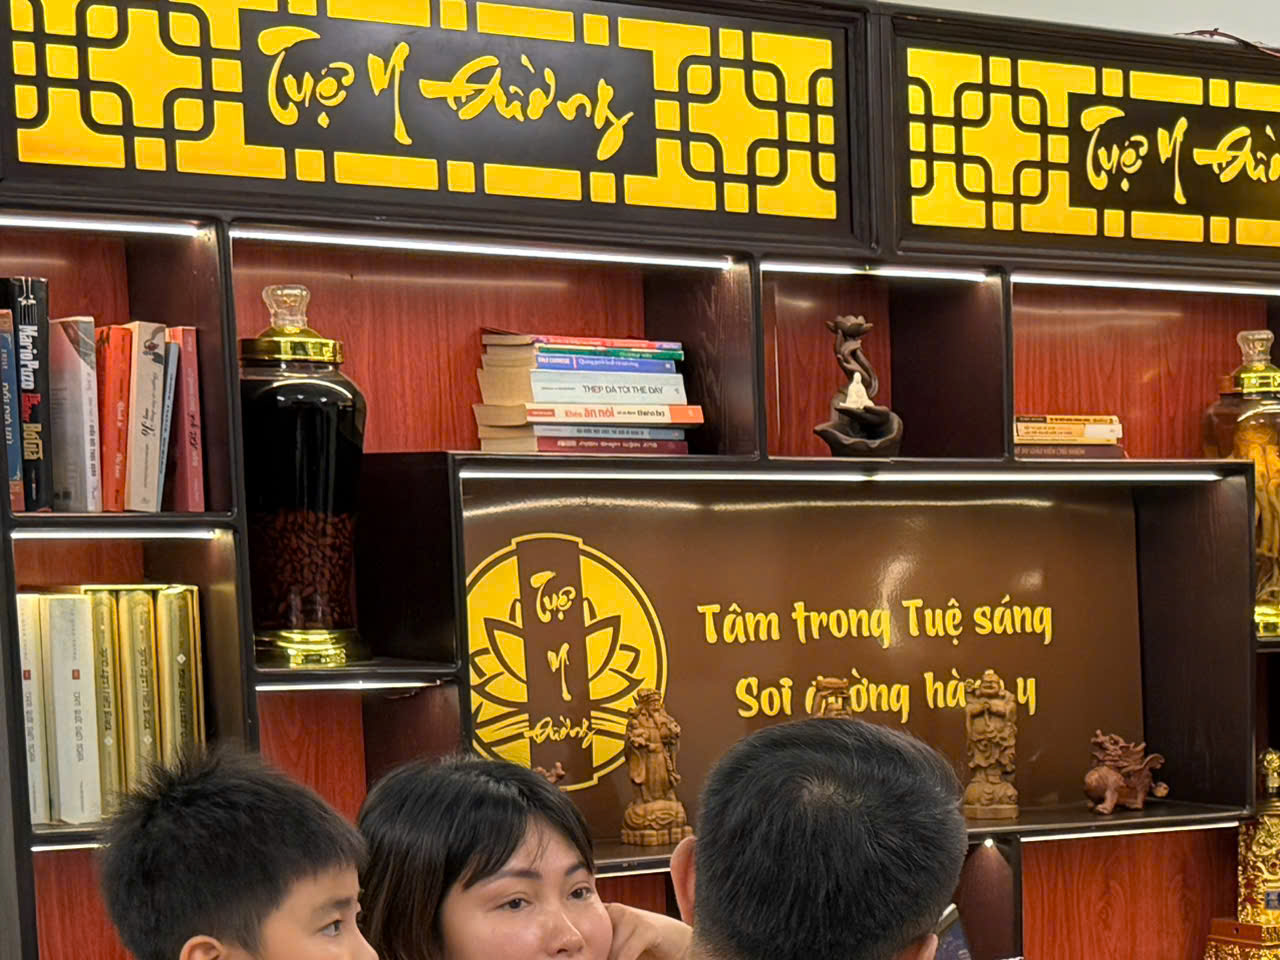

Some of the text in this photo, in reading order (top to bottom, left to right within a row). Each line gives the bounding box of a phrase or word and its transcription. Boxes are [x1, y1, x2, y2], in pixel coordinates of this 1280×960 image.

[258, 26, 355, 128] Tuệ
[1080, 105, 1149, 193] Tuệ
[530, 570, 577, 623] Tuệ
[697, 594, 1053, 649] Tâm trong Tuệ sáng
[735, 675, 794, 718] Soi
[1016, 677, 1036, 716] y
